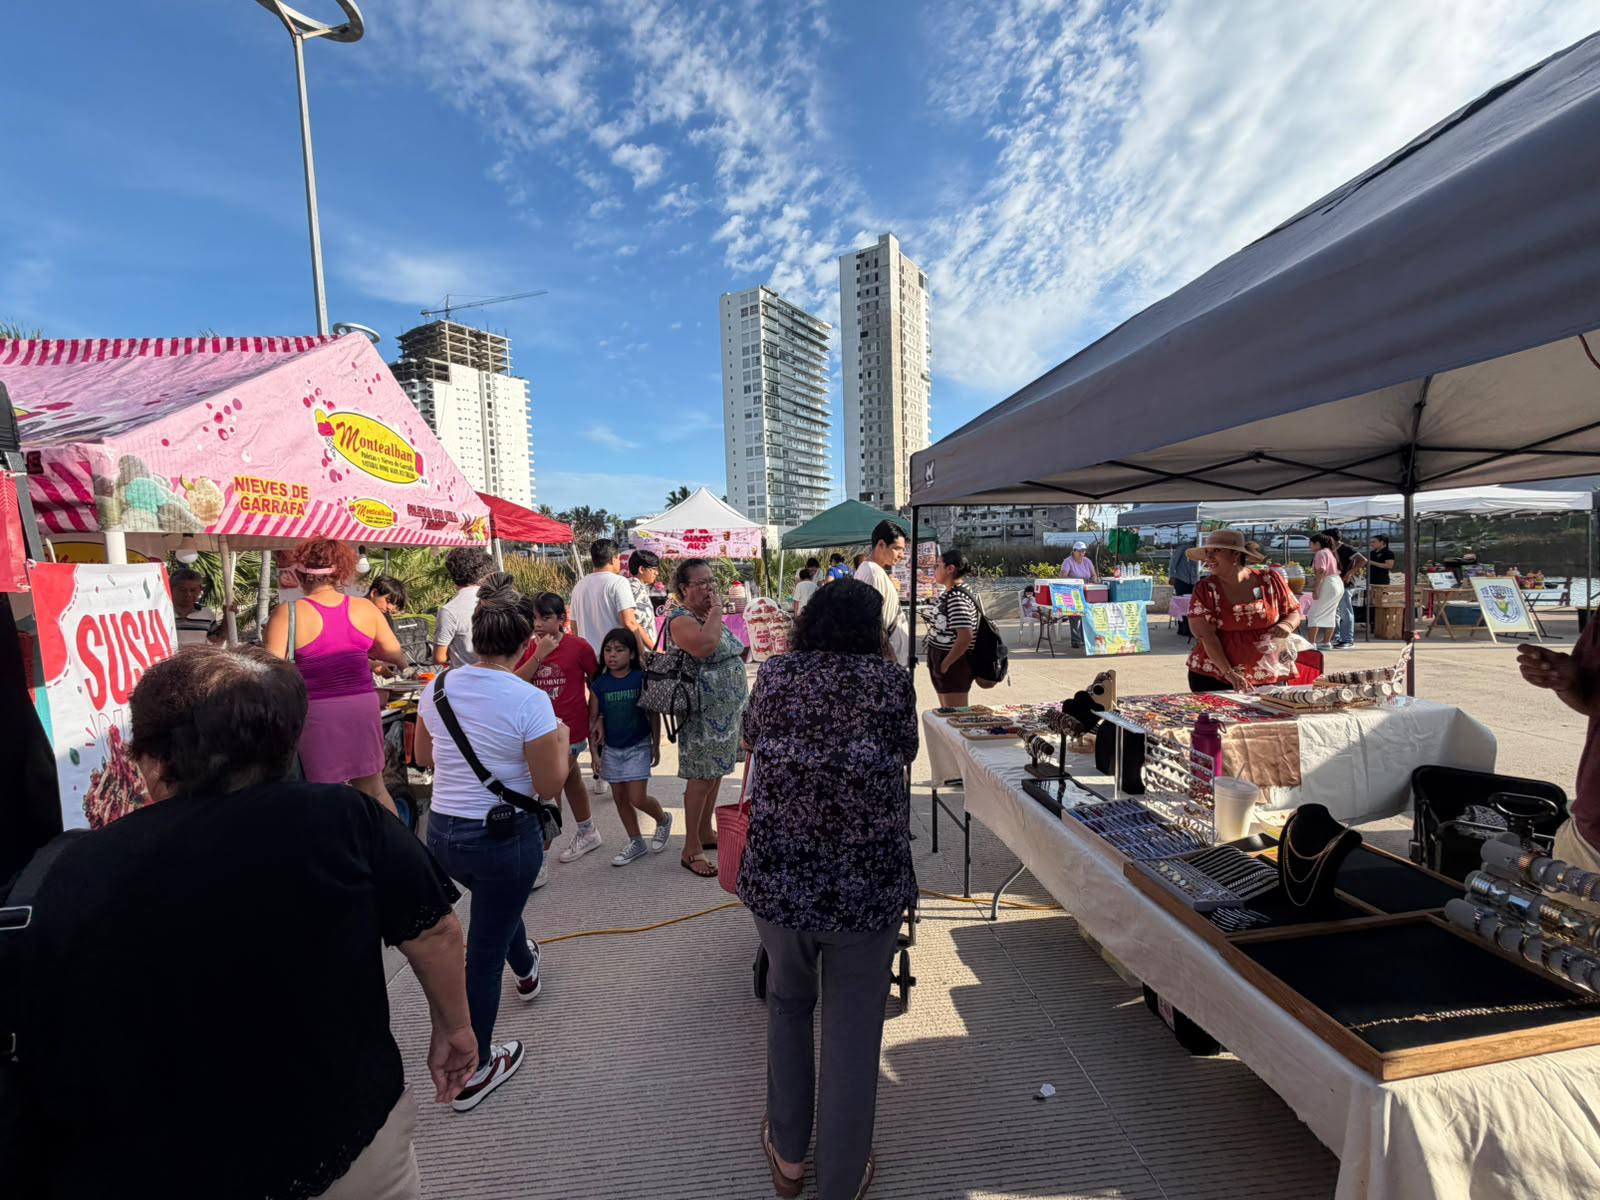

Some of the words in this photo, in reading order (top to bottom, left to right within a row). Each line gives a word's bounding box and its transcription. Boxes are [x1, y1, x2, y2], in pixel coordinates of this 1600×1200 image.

[336, 421, 413, 463] Montealban
[234, 476, 288, 497] NIEVES
[291, 484, 309, 500] DE
[240, 496, 305, 516] GARRAFA
[76, 609, 172, 711] SUSHI
